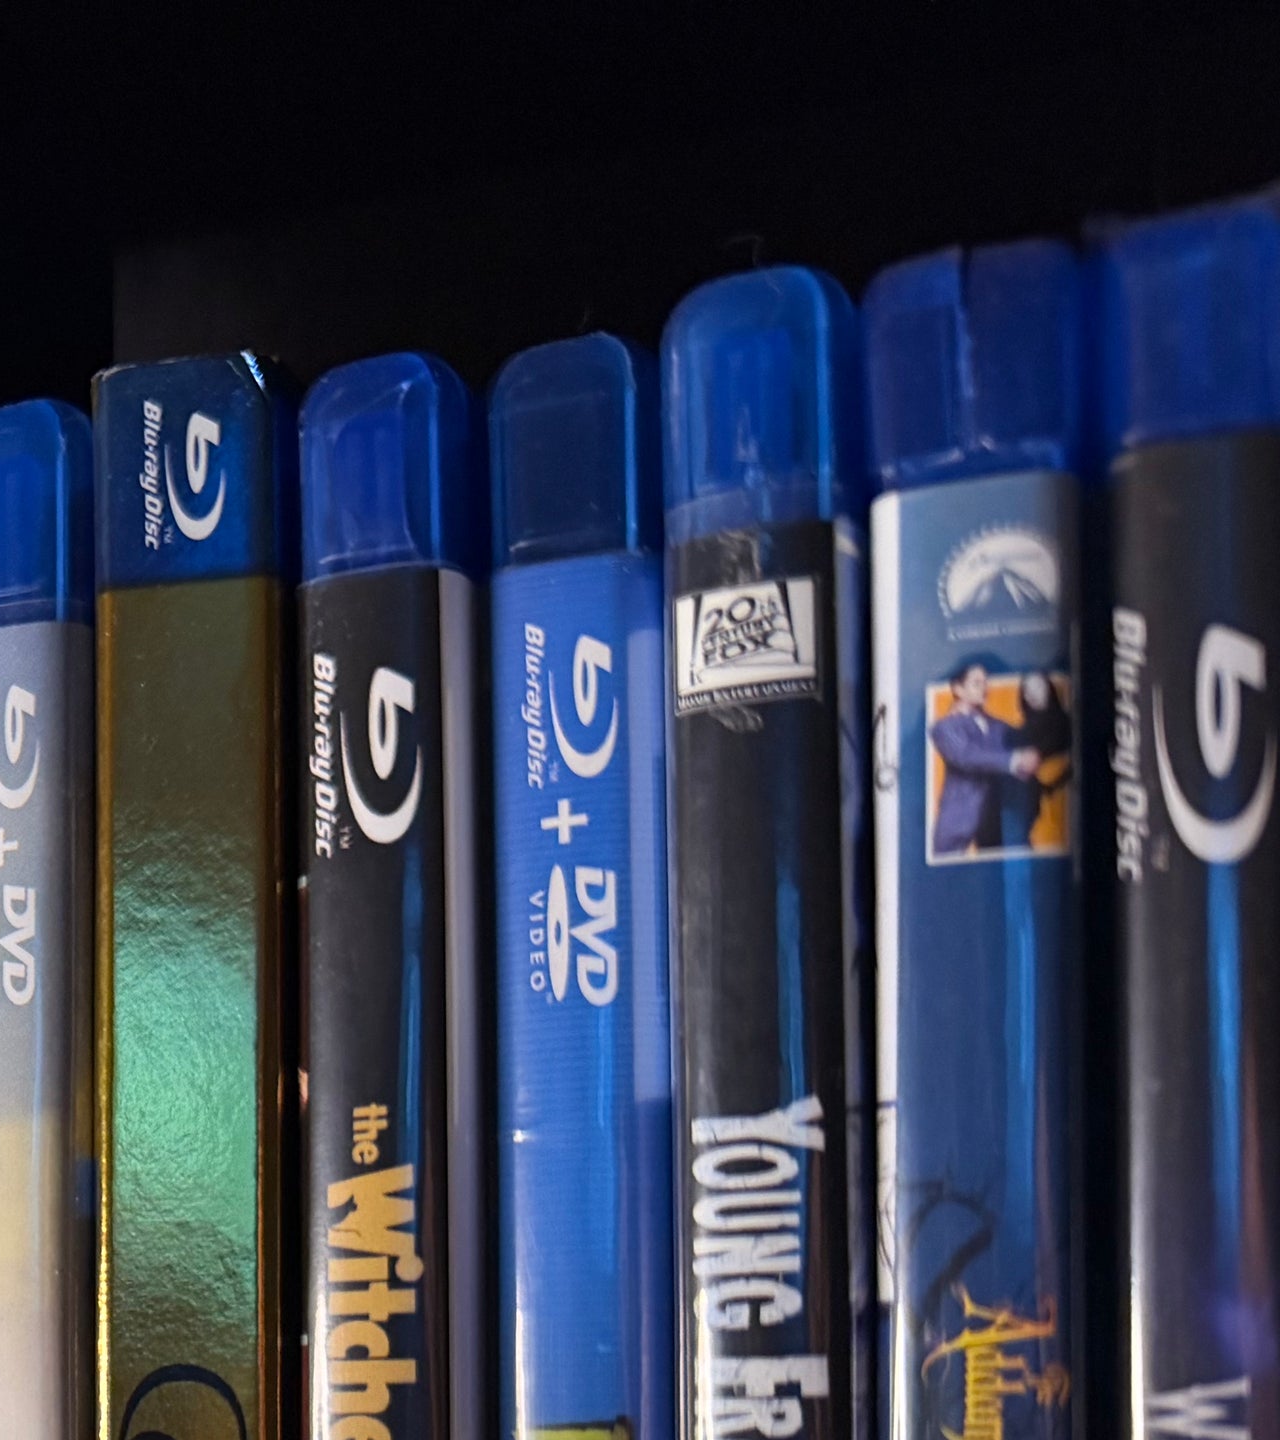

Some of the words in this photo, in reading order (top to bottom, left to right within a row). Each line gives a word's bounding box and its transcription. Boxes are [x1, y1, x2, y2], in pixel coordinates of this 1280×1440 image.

[528, 890, 545, 993] VIDEO
[574, 867, 620, 1007] DVD
[352, 1103, 389, 1165] the
[691, 1095, 825, 1332] YOUNG
